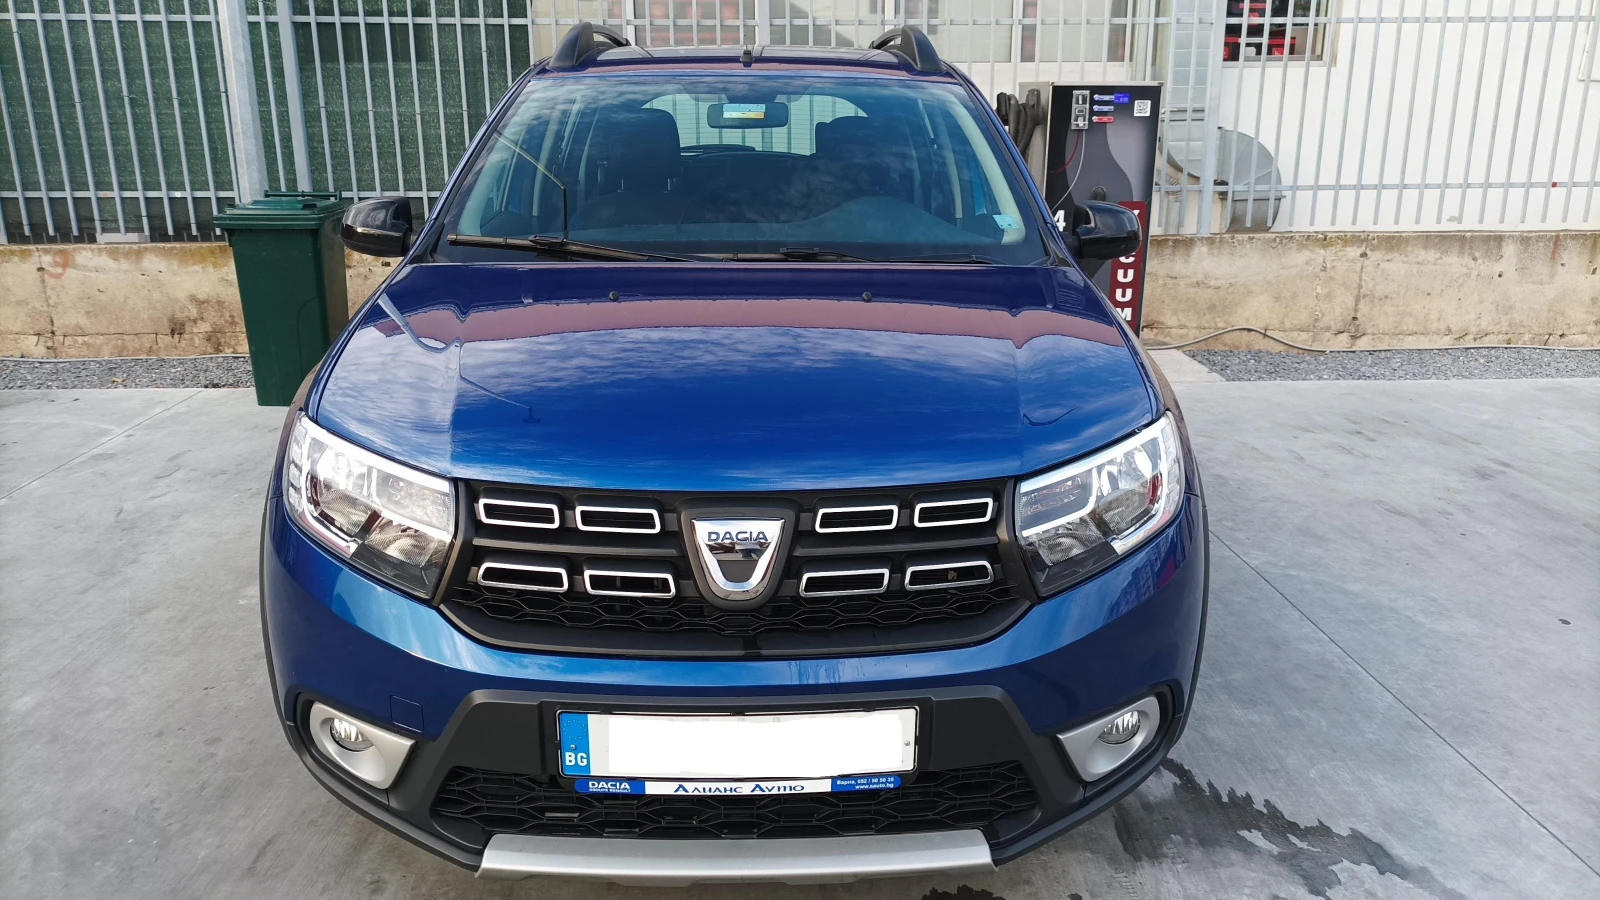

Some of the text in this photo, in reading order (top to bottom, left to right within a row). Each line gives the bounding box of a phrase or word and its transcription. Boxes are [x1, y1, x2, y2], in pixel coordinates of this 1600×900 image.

[1053, 209, 1066, 231] 4
[707, 531, 769, 542] DACIA
[565, 751, 588, 766] BG
[588, 781, 631, 790] DACIA
